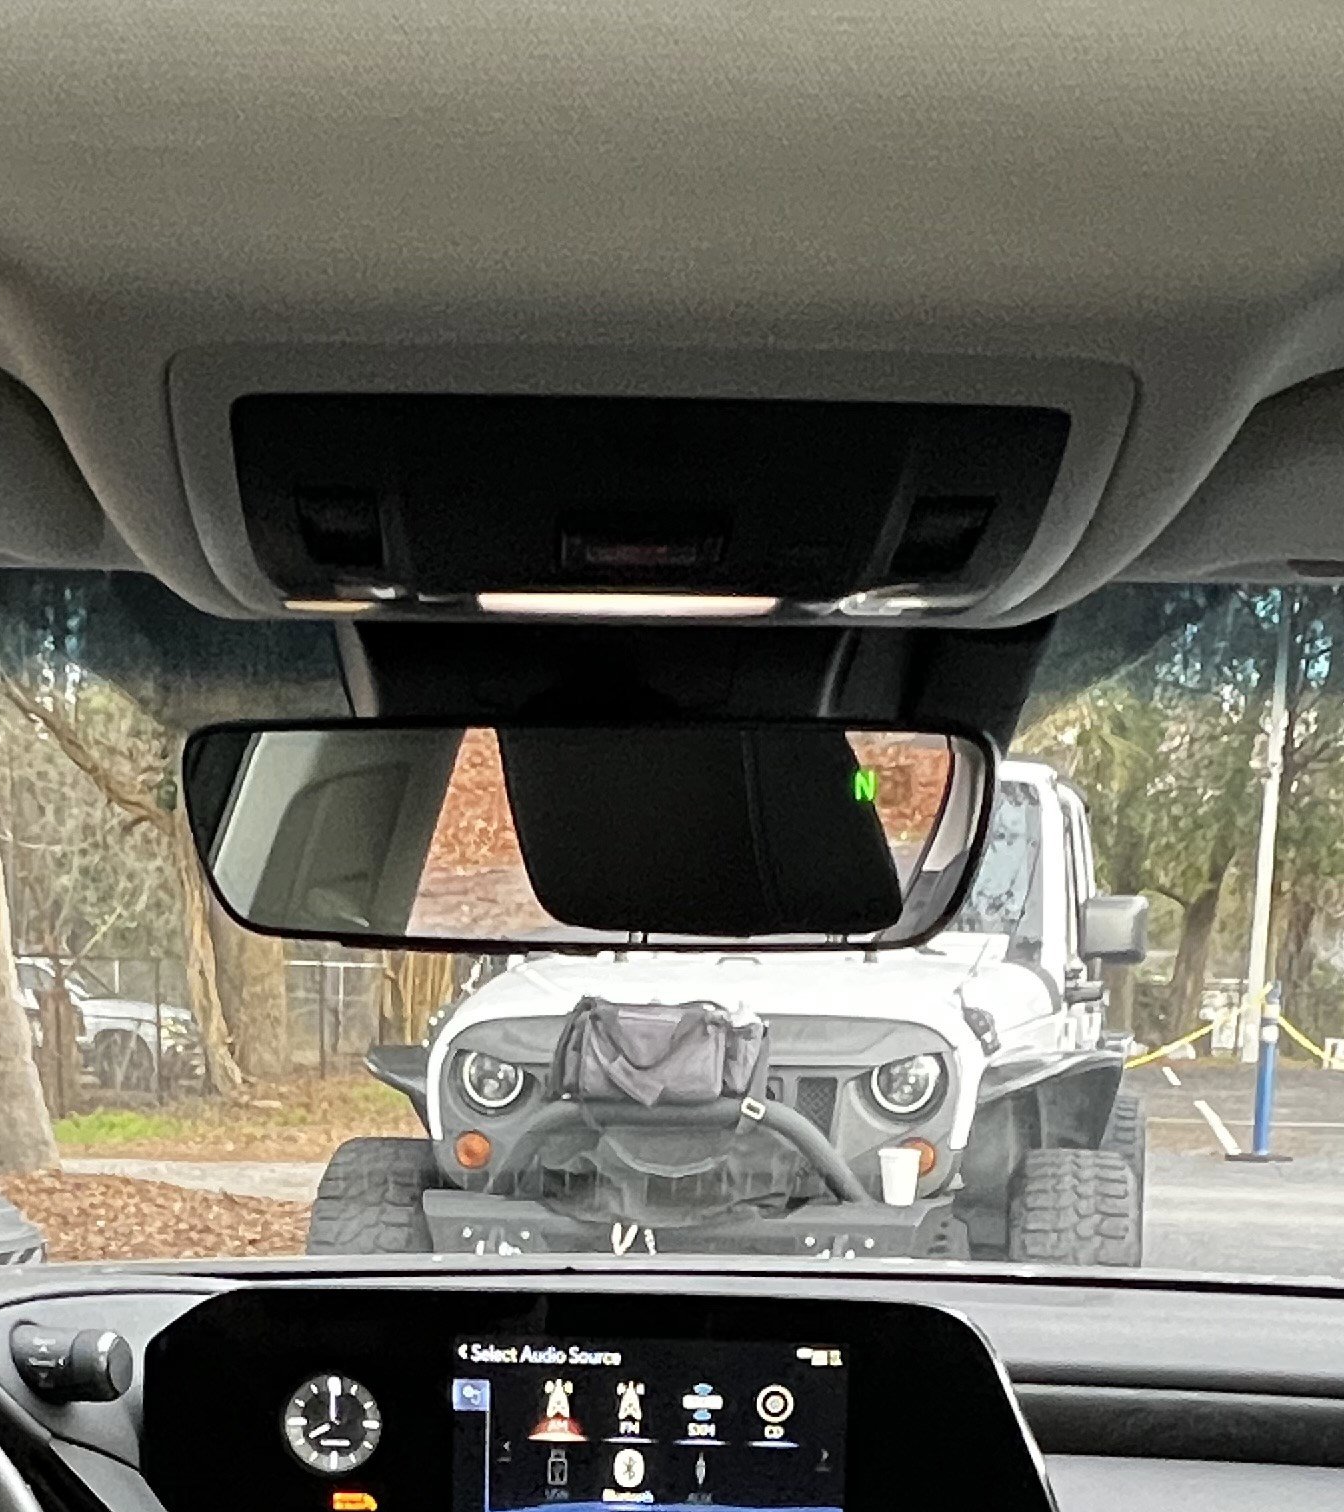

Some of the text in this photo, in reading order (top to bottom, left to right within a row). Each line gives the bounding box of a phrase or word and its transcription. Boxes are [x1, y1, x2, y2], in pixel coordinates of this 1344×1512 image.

[855, 771, 873, 800] N
[471, 1344, 622, 1366] Select Audio Source
